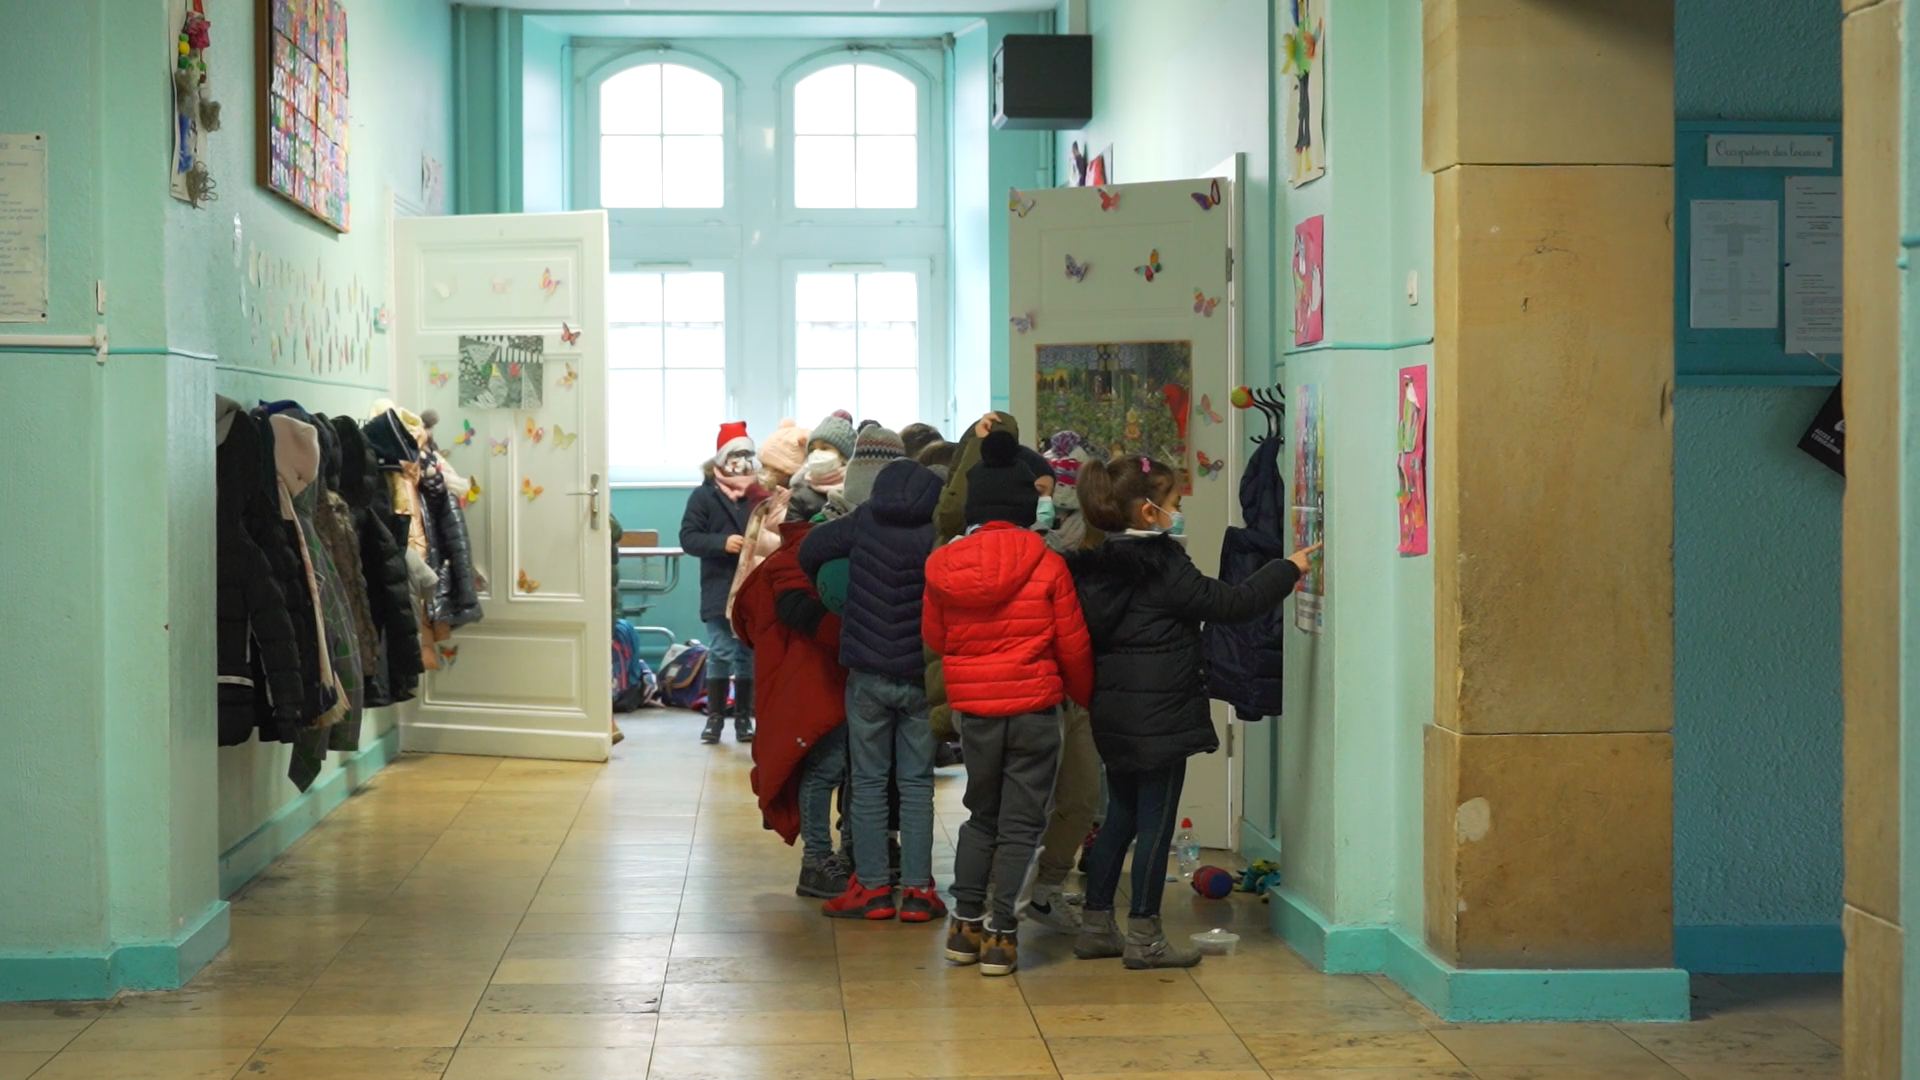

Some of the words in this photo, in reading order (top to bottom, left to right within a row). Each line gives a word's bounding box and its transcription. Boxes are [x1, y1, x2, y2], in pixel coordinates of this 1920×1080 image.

[1715, 139, 1771, 164] Occupation
[1772, 145, 1788, 157] des
[1790, 141, 1823, 157] locaux
